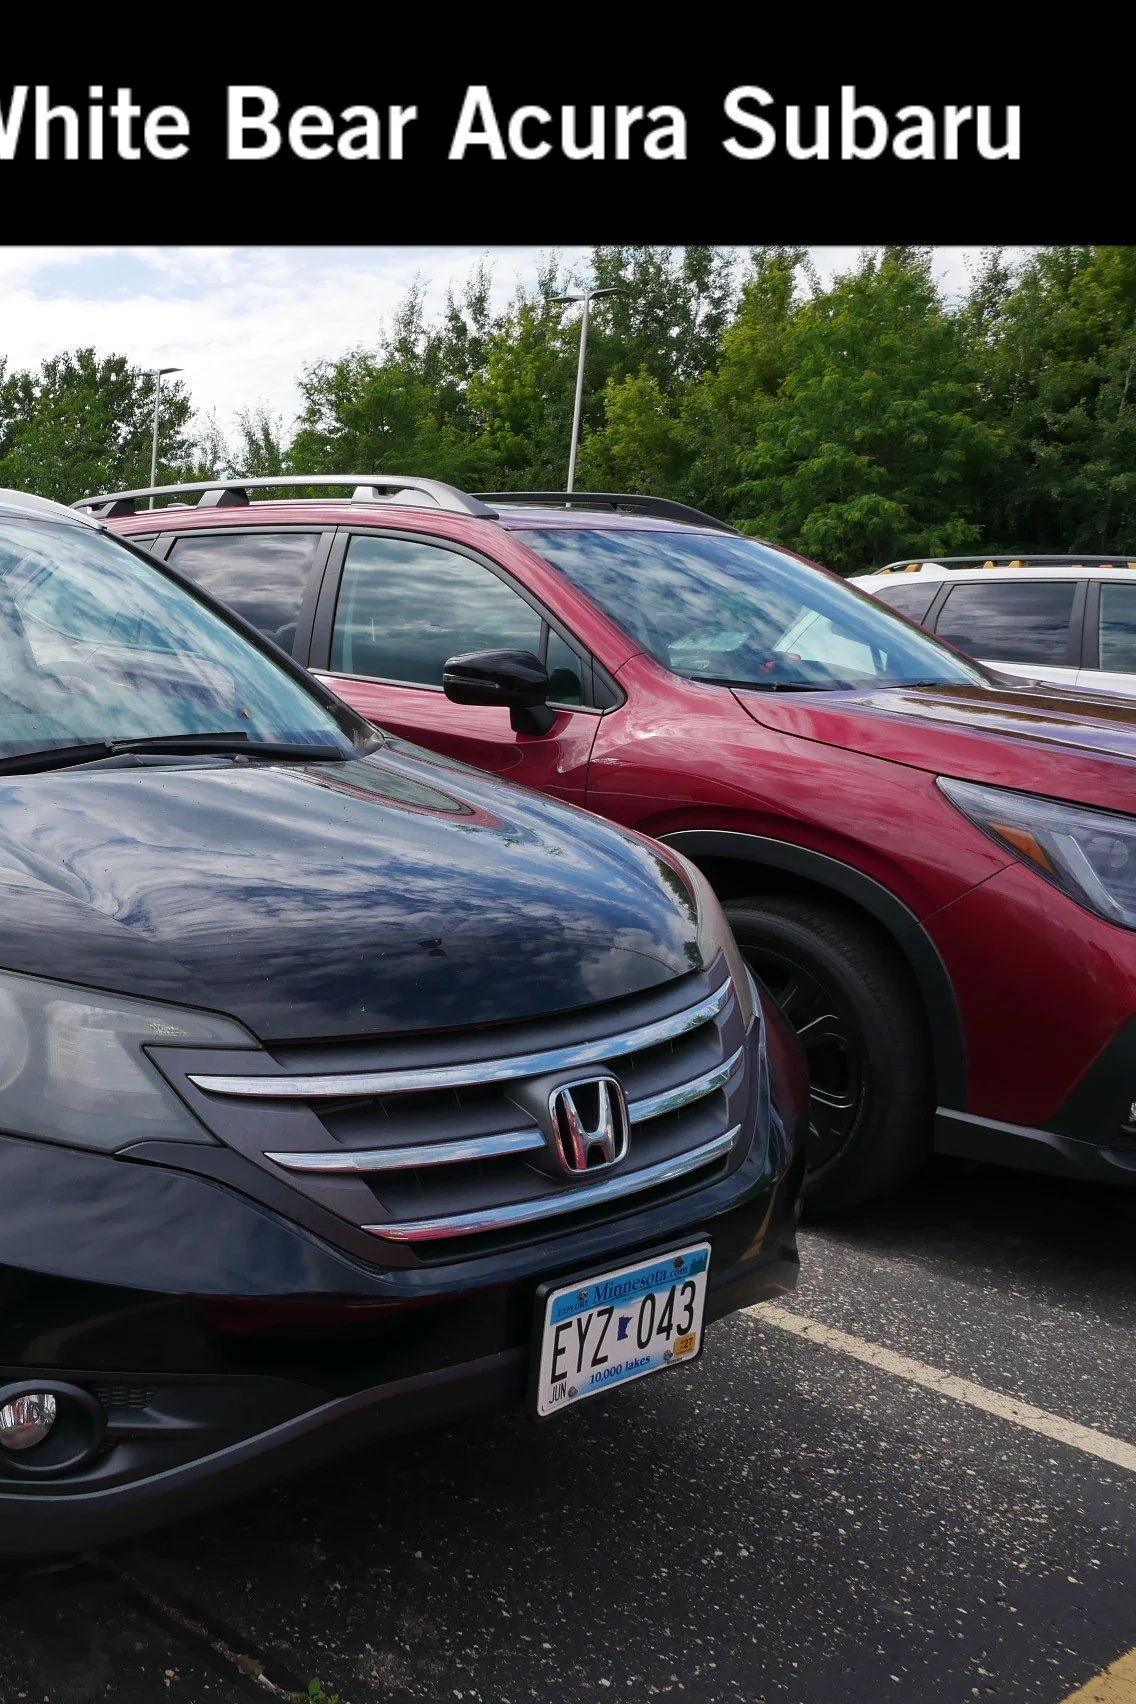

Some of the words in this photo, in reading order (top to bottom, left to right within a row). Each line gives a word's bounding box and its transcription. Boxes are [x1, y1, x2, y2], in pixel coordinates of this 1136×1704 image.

[558, 1300, 589, 1317] EXPLORE
[550, 1305, 615, 1385] EYZ
[636, 1280, 696, 1350] 043
[589, 1363, 623, 1385] 10,000
[624, 1355, 651, 1372] lakes
[548, 1382, 567, 1404] JUN
